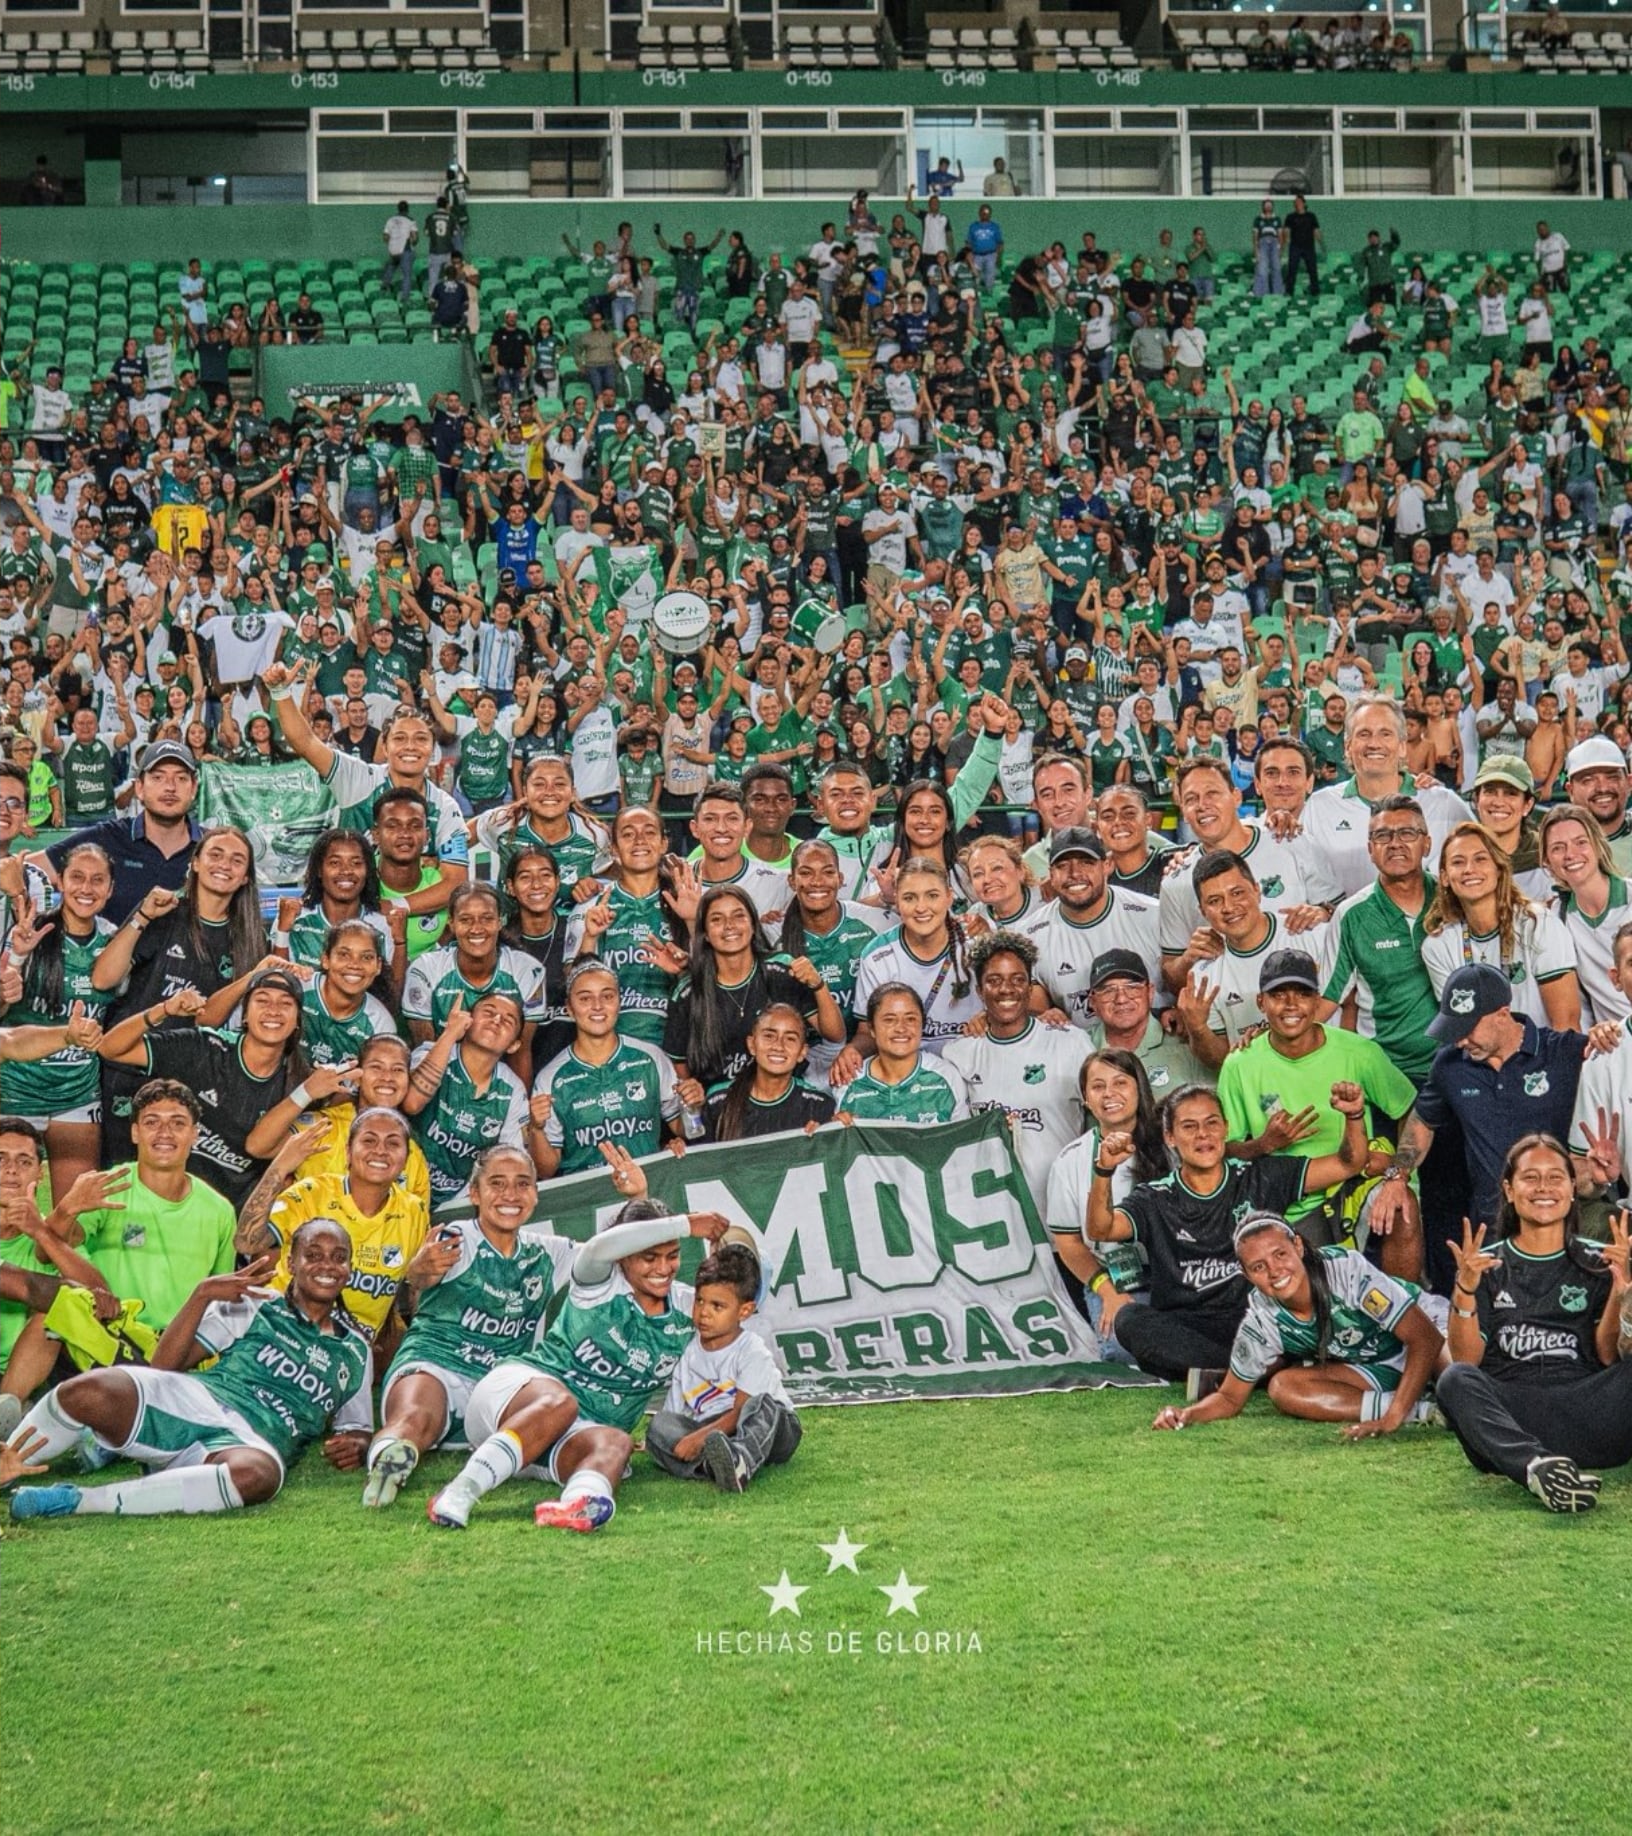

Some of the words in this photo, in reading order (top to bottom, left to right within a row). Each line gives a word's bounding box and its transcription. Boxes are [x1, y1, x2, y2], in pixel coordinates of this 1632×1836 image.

[1, 76, 34, 91] -155
[594, 1137, 1036, 1306] MOS
[775, 1298, 1070, 1376] RERAS
[1498, 1331, 1578, 1360] Muñeca
